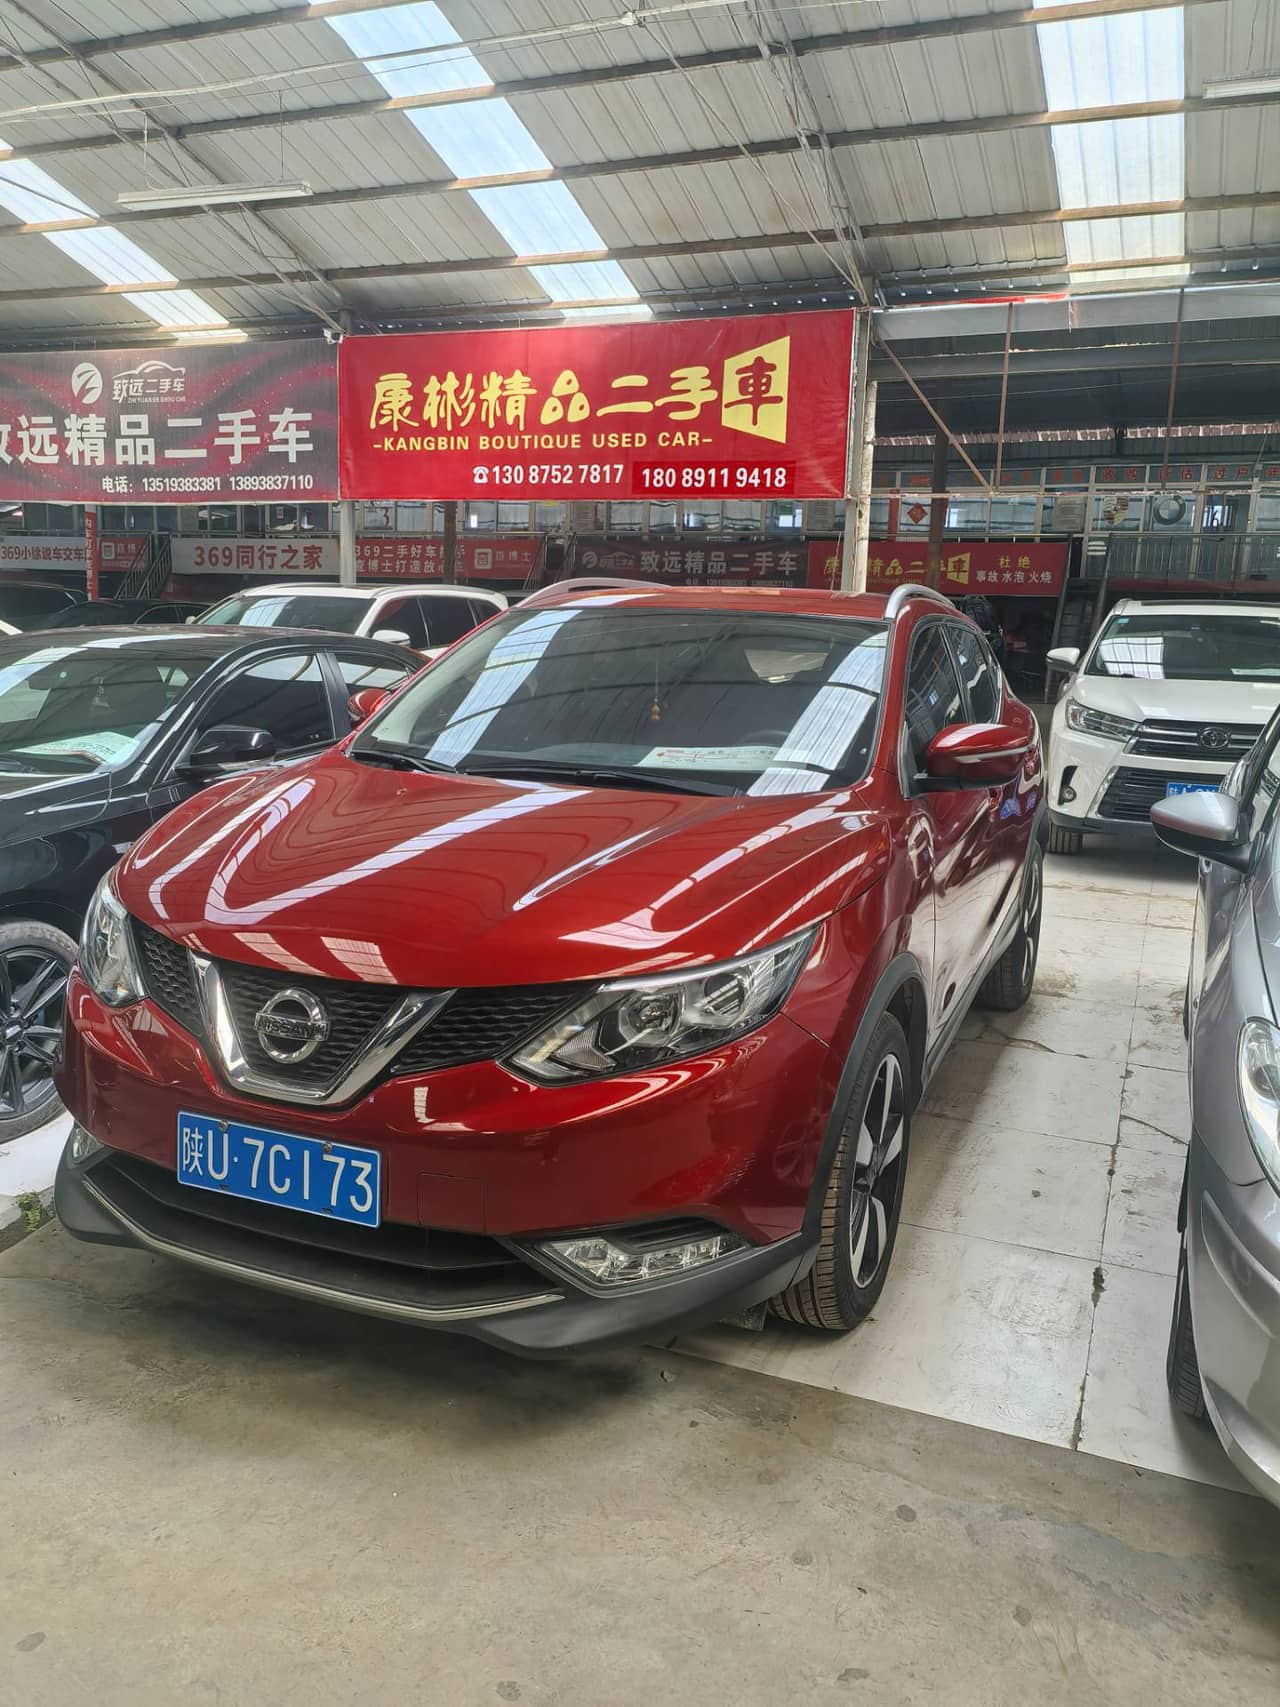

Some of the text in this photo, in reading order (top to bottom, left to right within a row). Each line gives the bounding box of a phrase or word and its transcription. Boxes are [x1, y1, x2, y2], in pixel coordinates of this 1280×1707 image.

[112, 379, 185, 403] 致远二手车
[479, 434, 582, 450] BOUTIQUE
[592, 433, 648, 448] USED
[142, 476, 221, 492] 13519383381
[229, 474, 314, 491] 13893837110
[492, 463, 624, 484] 130 8752 7817
[642, 467, 787, 488] 180 8911 9418
[194, 544, 323, 570] 369同行之家
[640, 550, 798, 576] 致远精品二手车
